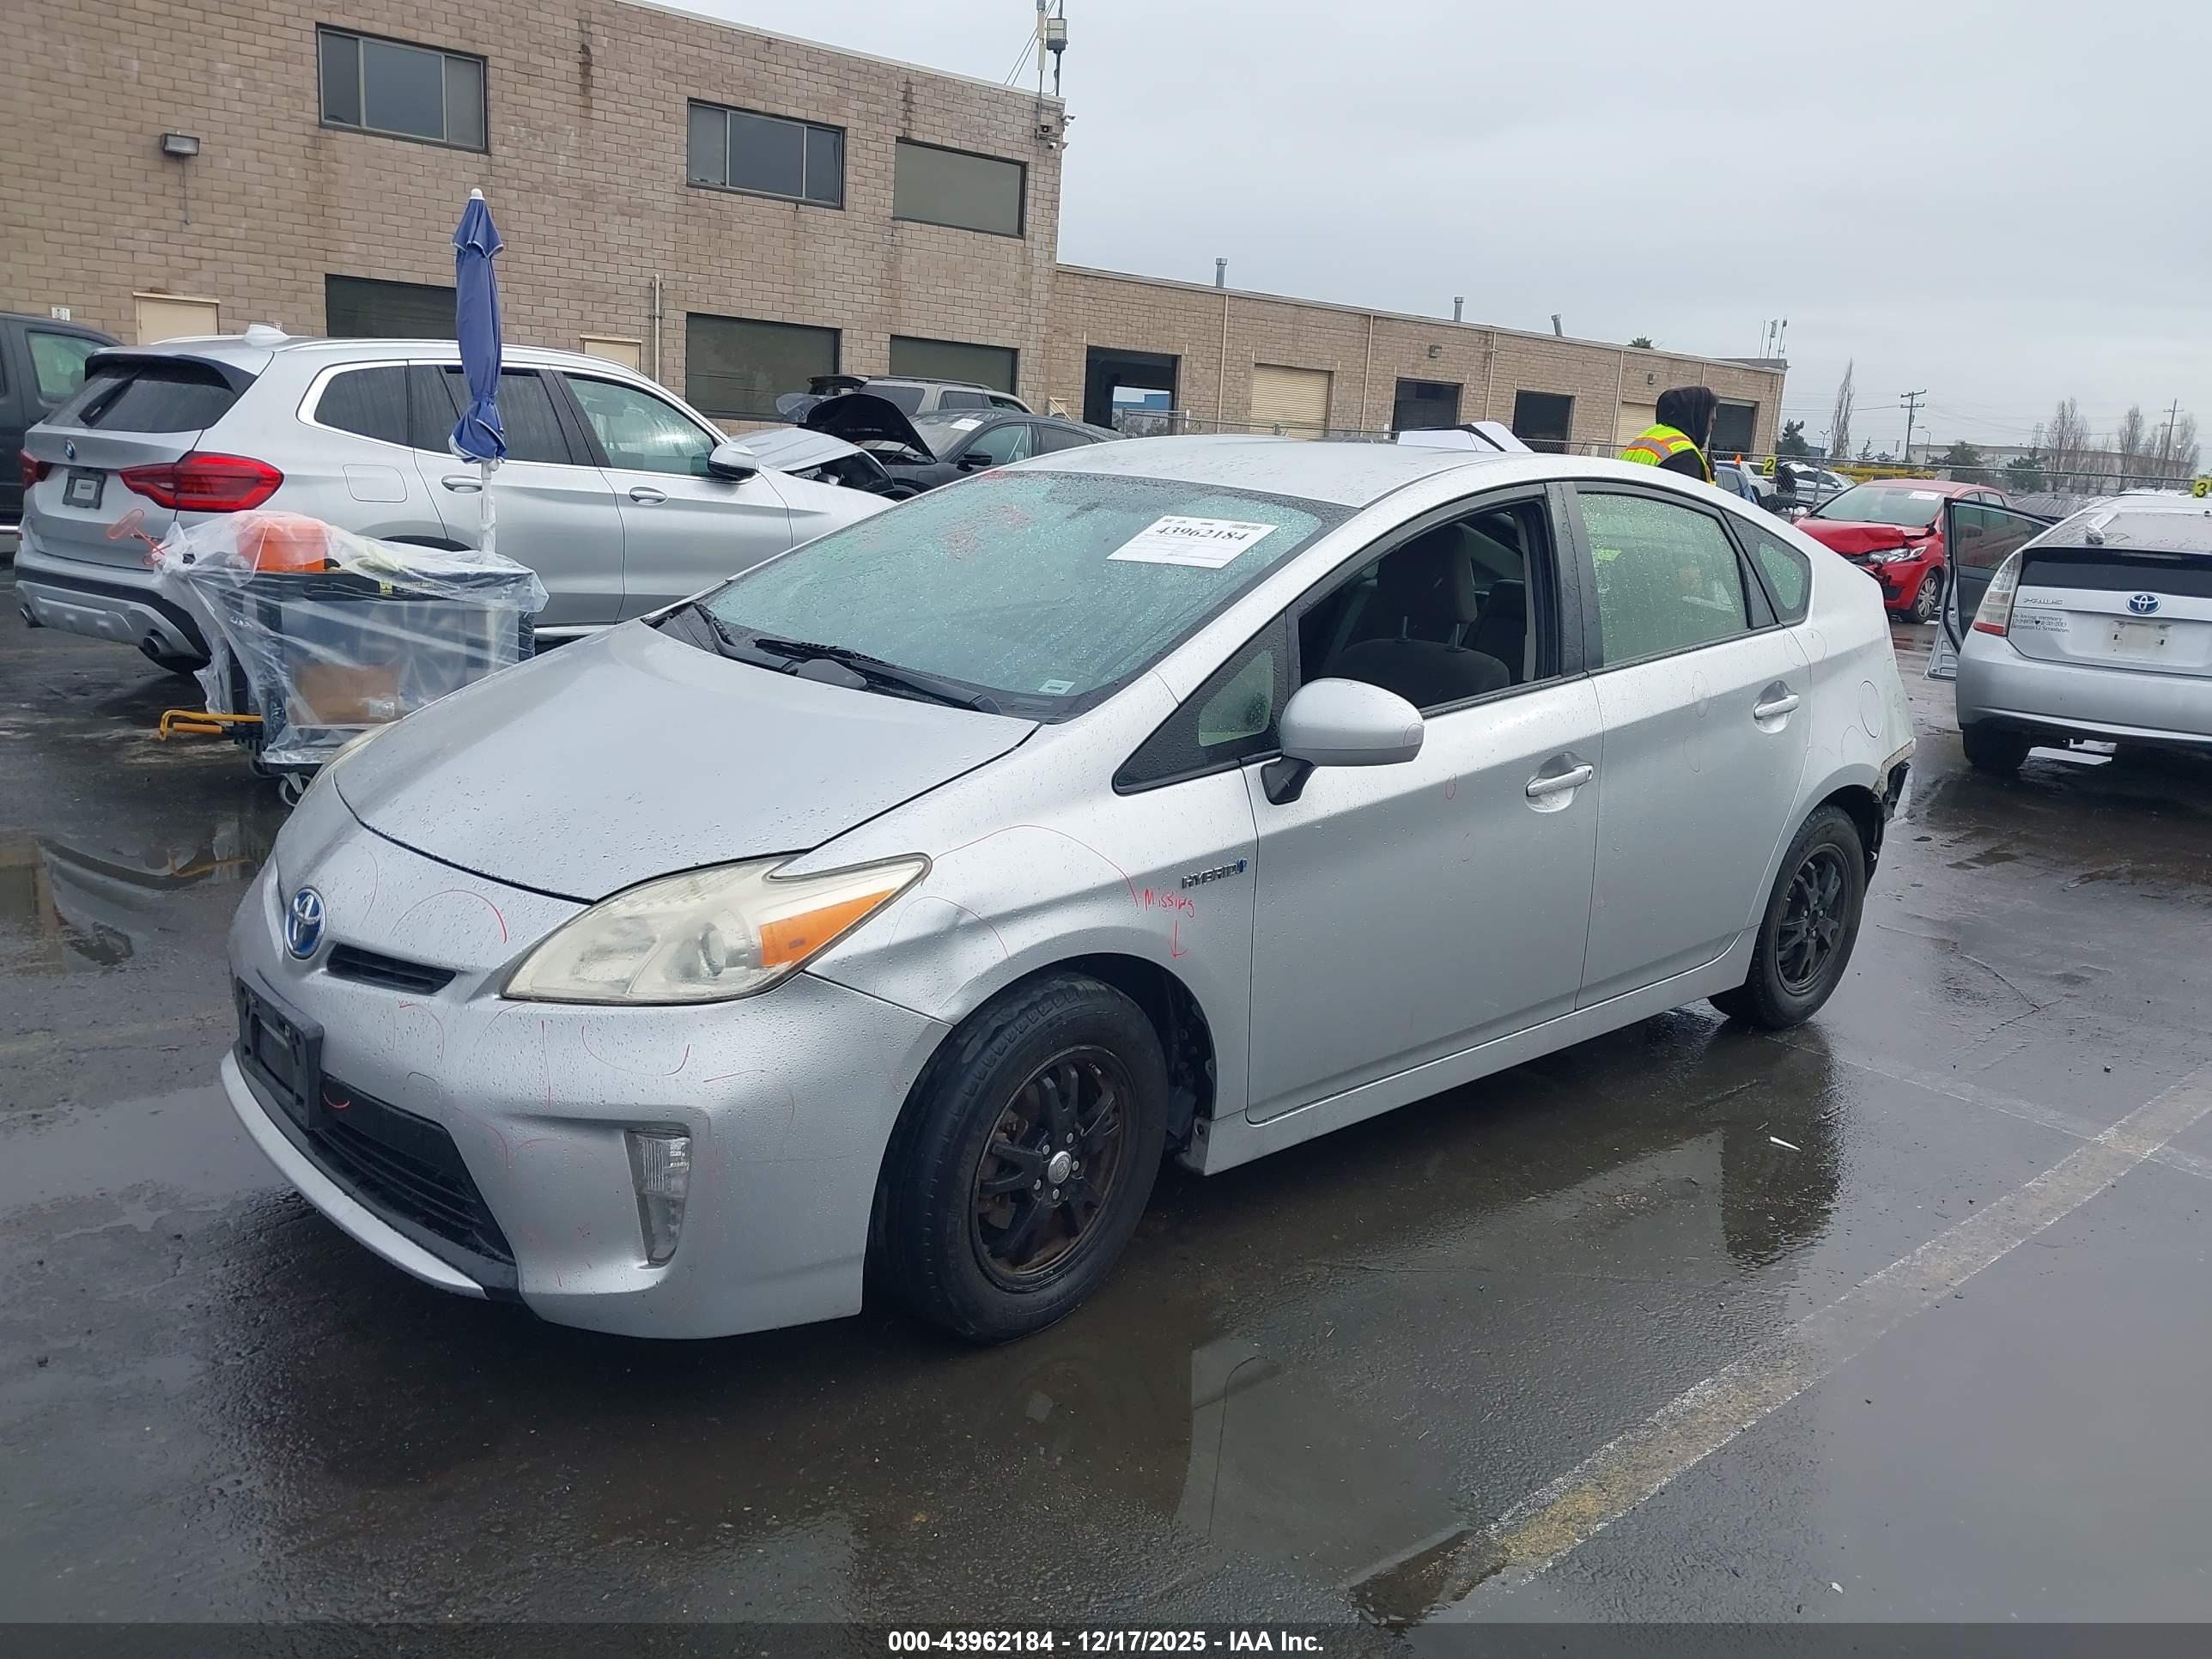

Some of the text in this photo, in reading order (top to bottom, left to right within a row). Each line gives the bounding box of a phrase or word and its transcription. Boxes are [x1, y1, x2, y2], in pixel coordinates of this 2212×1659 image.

[1765, 459, 1775, 472] 2
[2195, 482, 2208, 498] 3
[1156, 526, 1249, 541] 43962184
[2023, 597, 2063, 605] PRIUS
[1182, 863, 1237, 889] HYBRID
